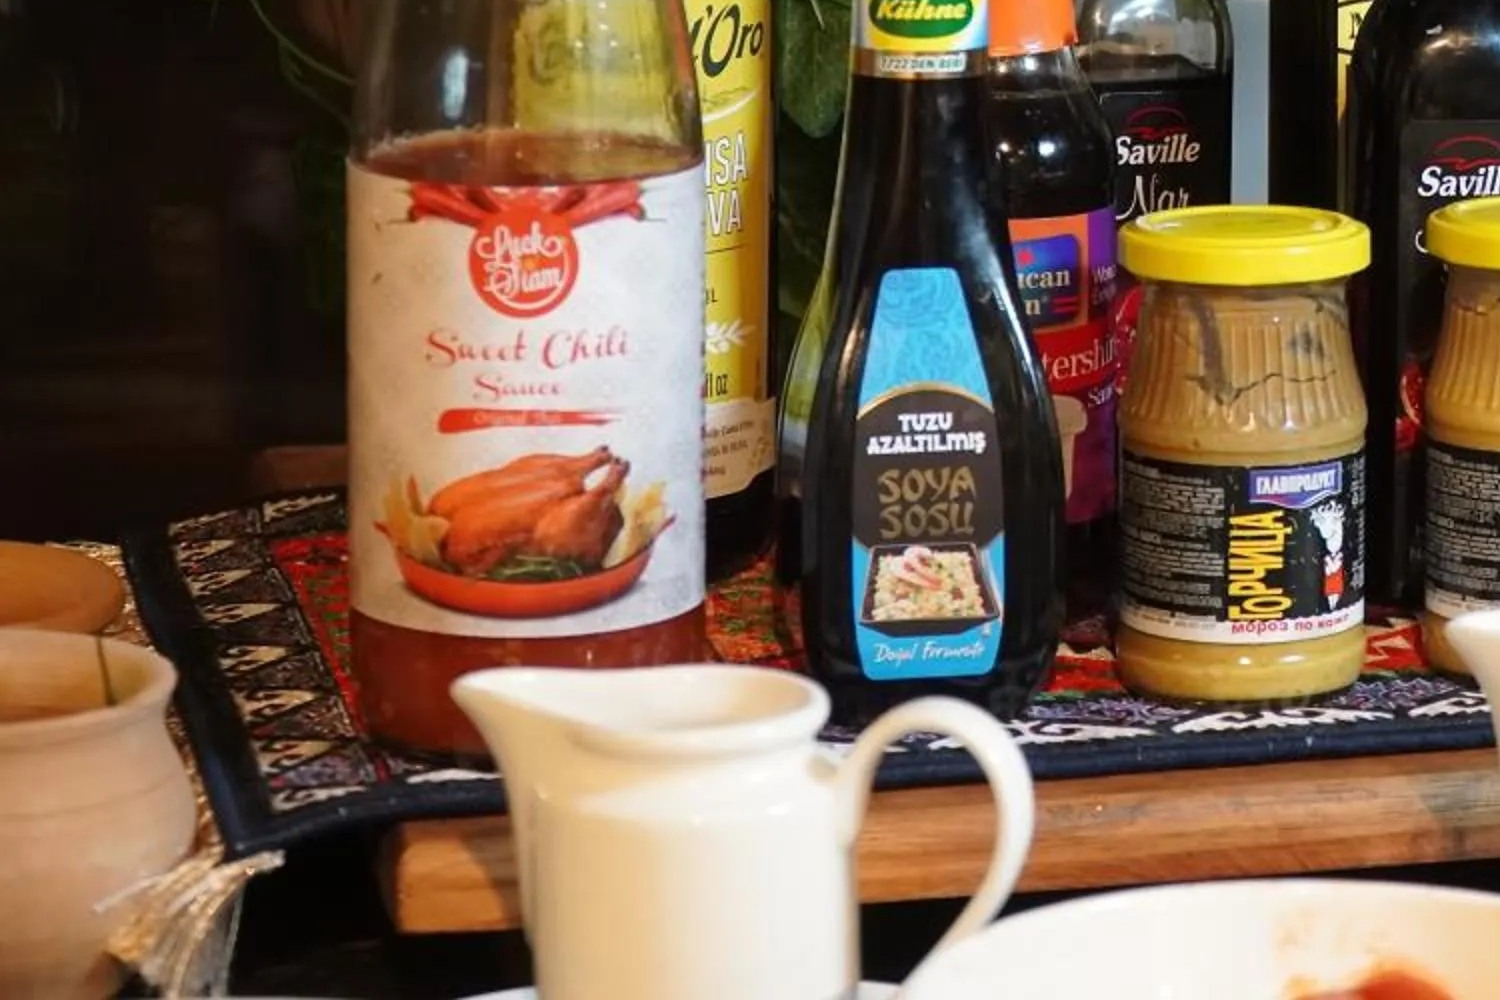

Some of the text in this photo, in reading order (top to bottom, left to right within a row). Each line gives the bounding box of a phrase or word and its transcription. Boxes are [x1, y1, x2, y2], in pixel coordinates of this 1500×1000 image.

[1115, 134, 1200, 166] Saville
[425, 325, 629, 370] Sweet Chili
[472, 371, 564, 402] Sauce
[898, 412, 953, 432] TUZU
[866, 432, 987, 455] AZALTILMIŞ
[877, 465, 976, 504] SOYA
[879, 502, 976, 540] SOSU
[1228, 510, 1292, 621] ГОРЧИЦА
